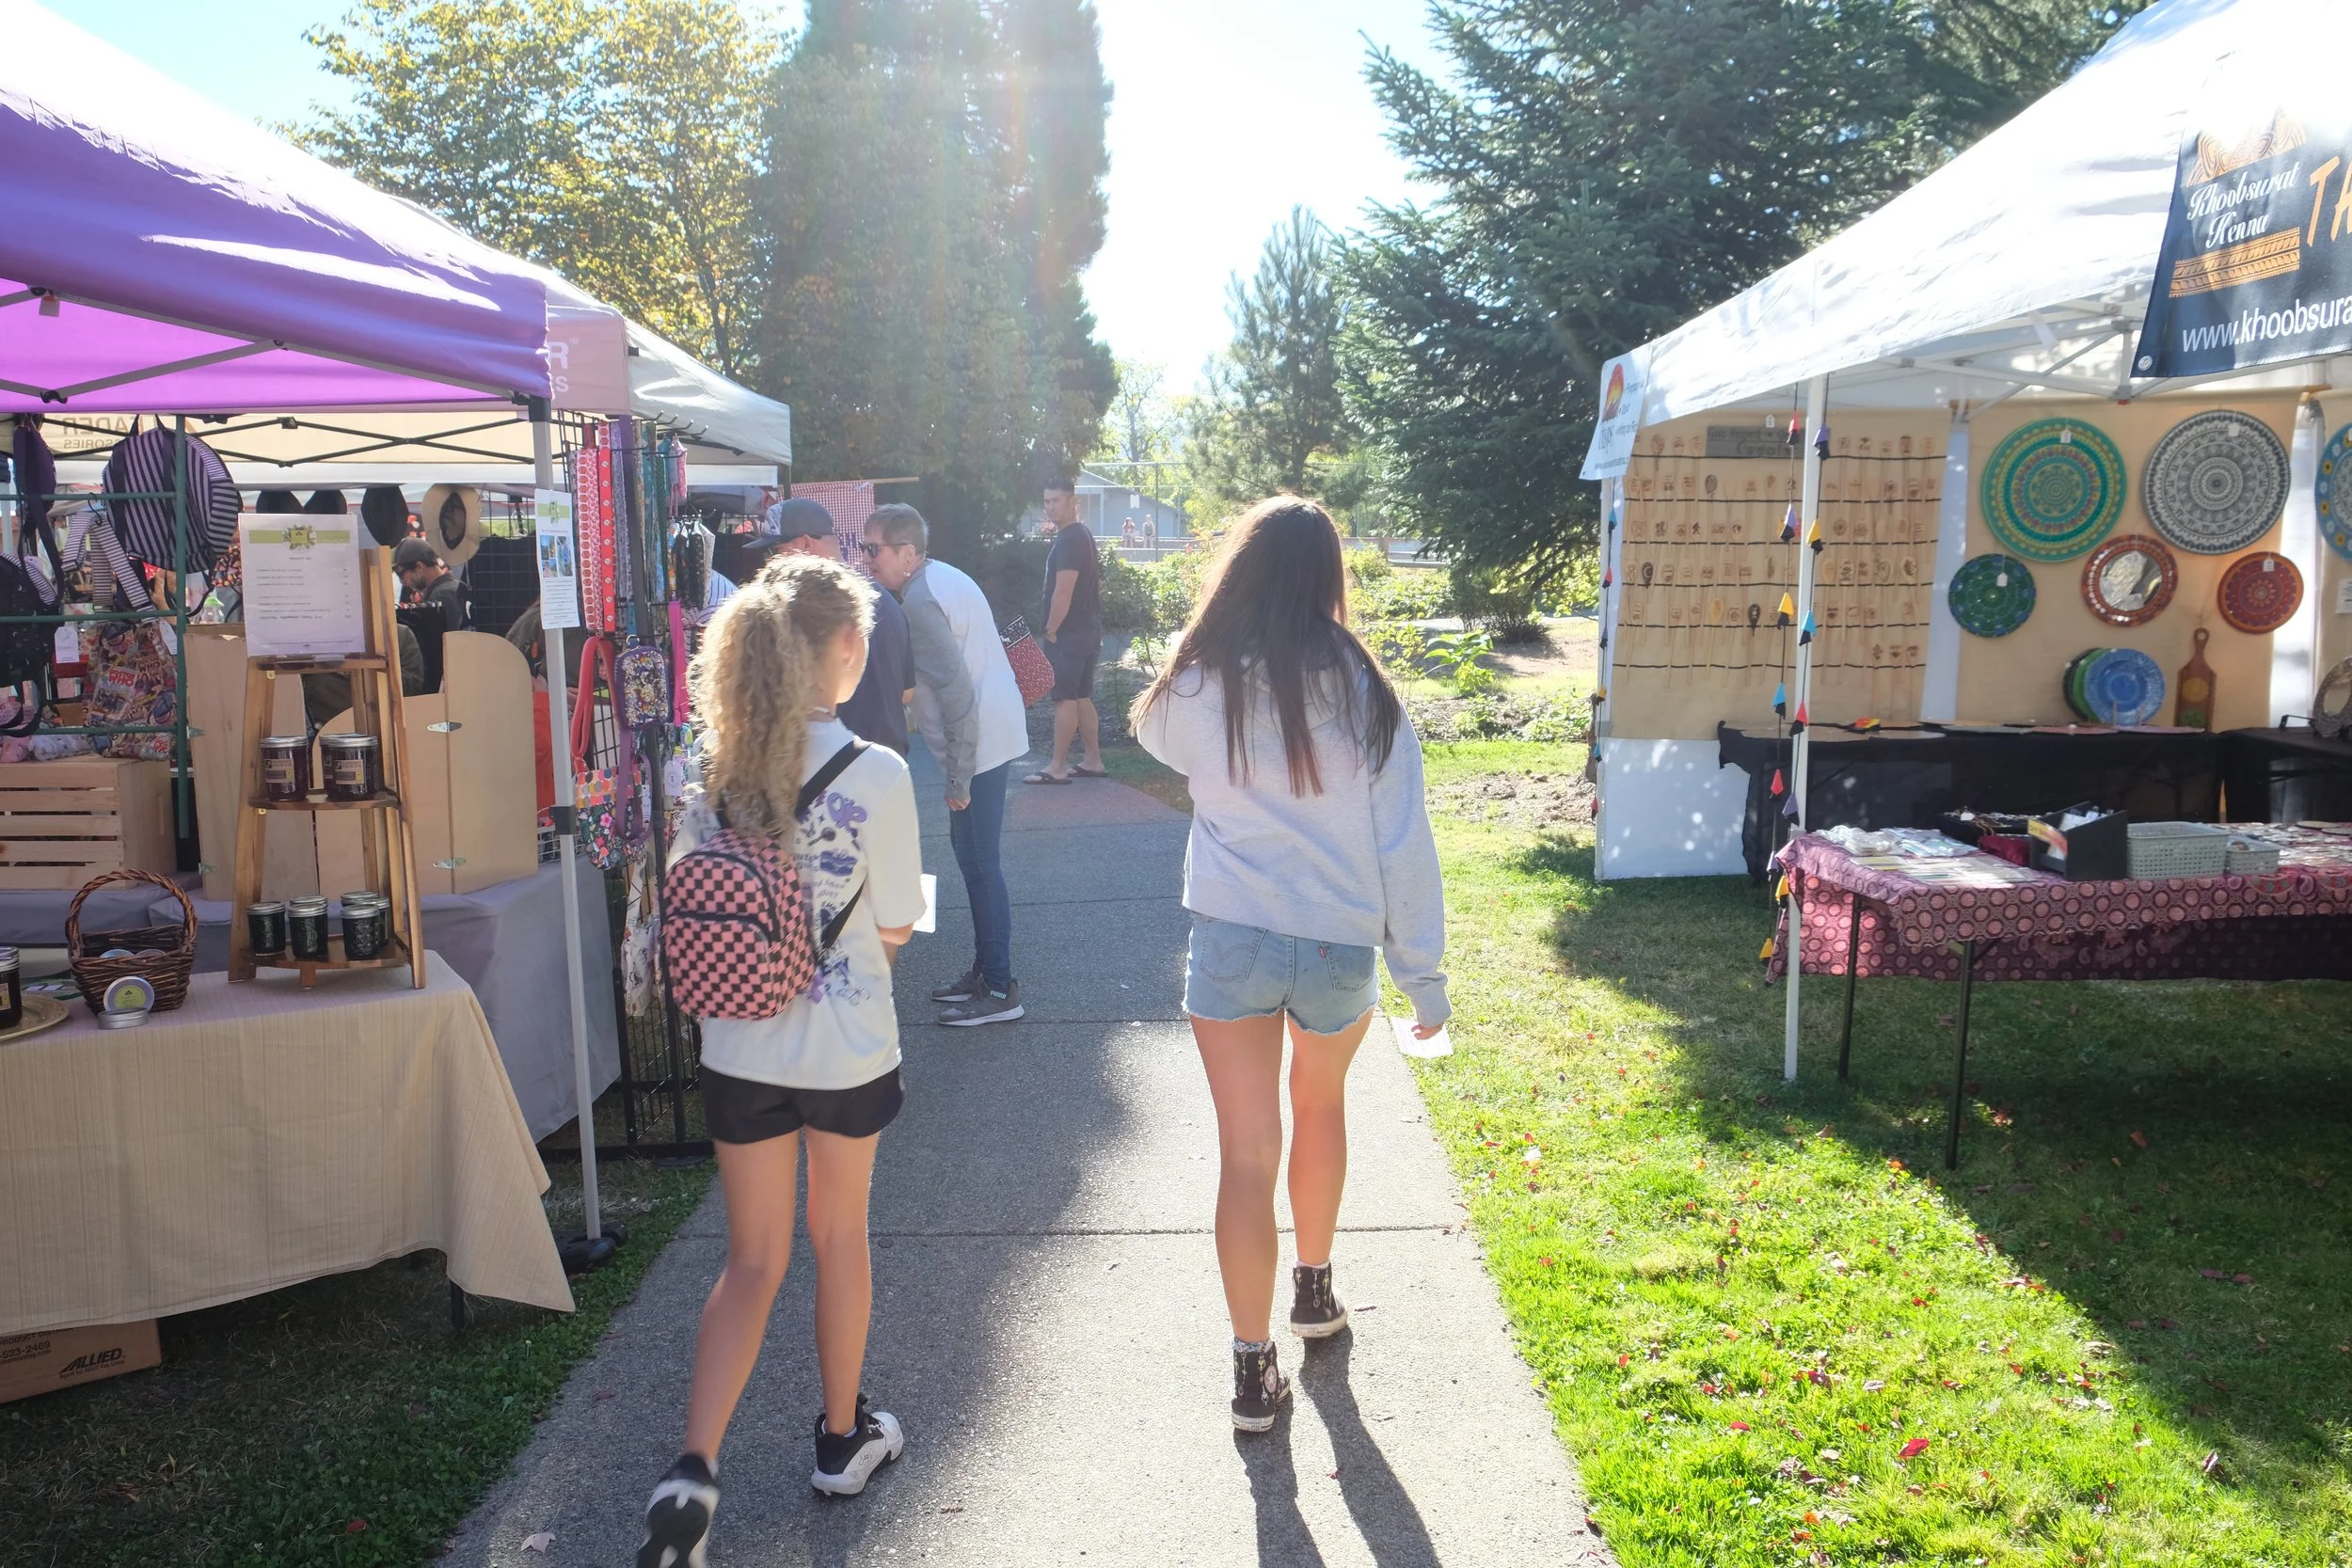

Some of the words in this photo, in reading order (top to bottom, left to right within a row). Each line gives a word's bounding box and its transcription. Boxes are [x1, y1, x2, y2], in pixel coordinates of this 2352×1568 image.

[2186, 161, 2300, 220] Khoobsurat
[2183, 294, 2352, 353] www.khoobsura
[59, 1347, 122, 1374] ALLIED
